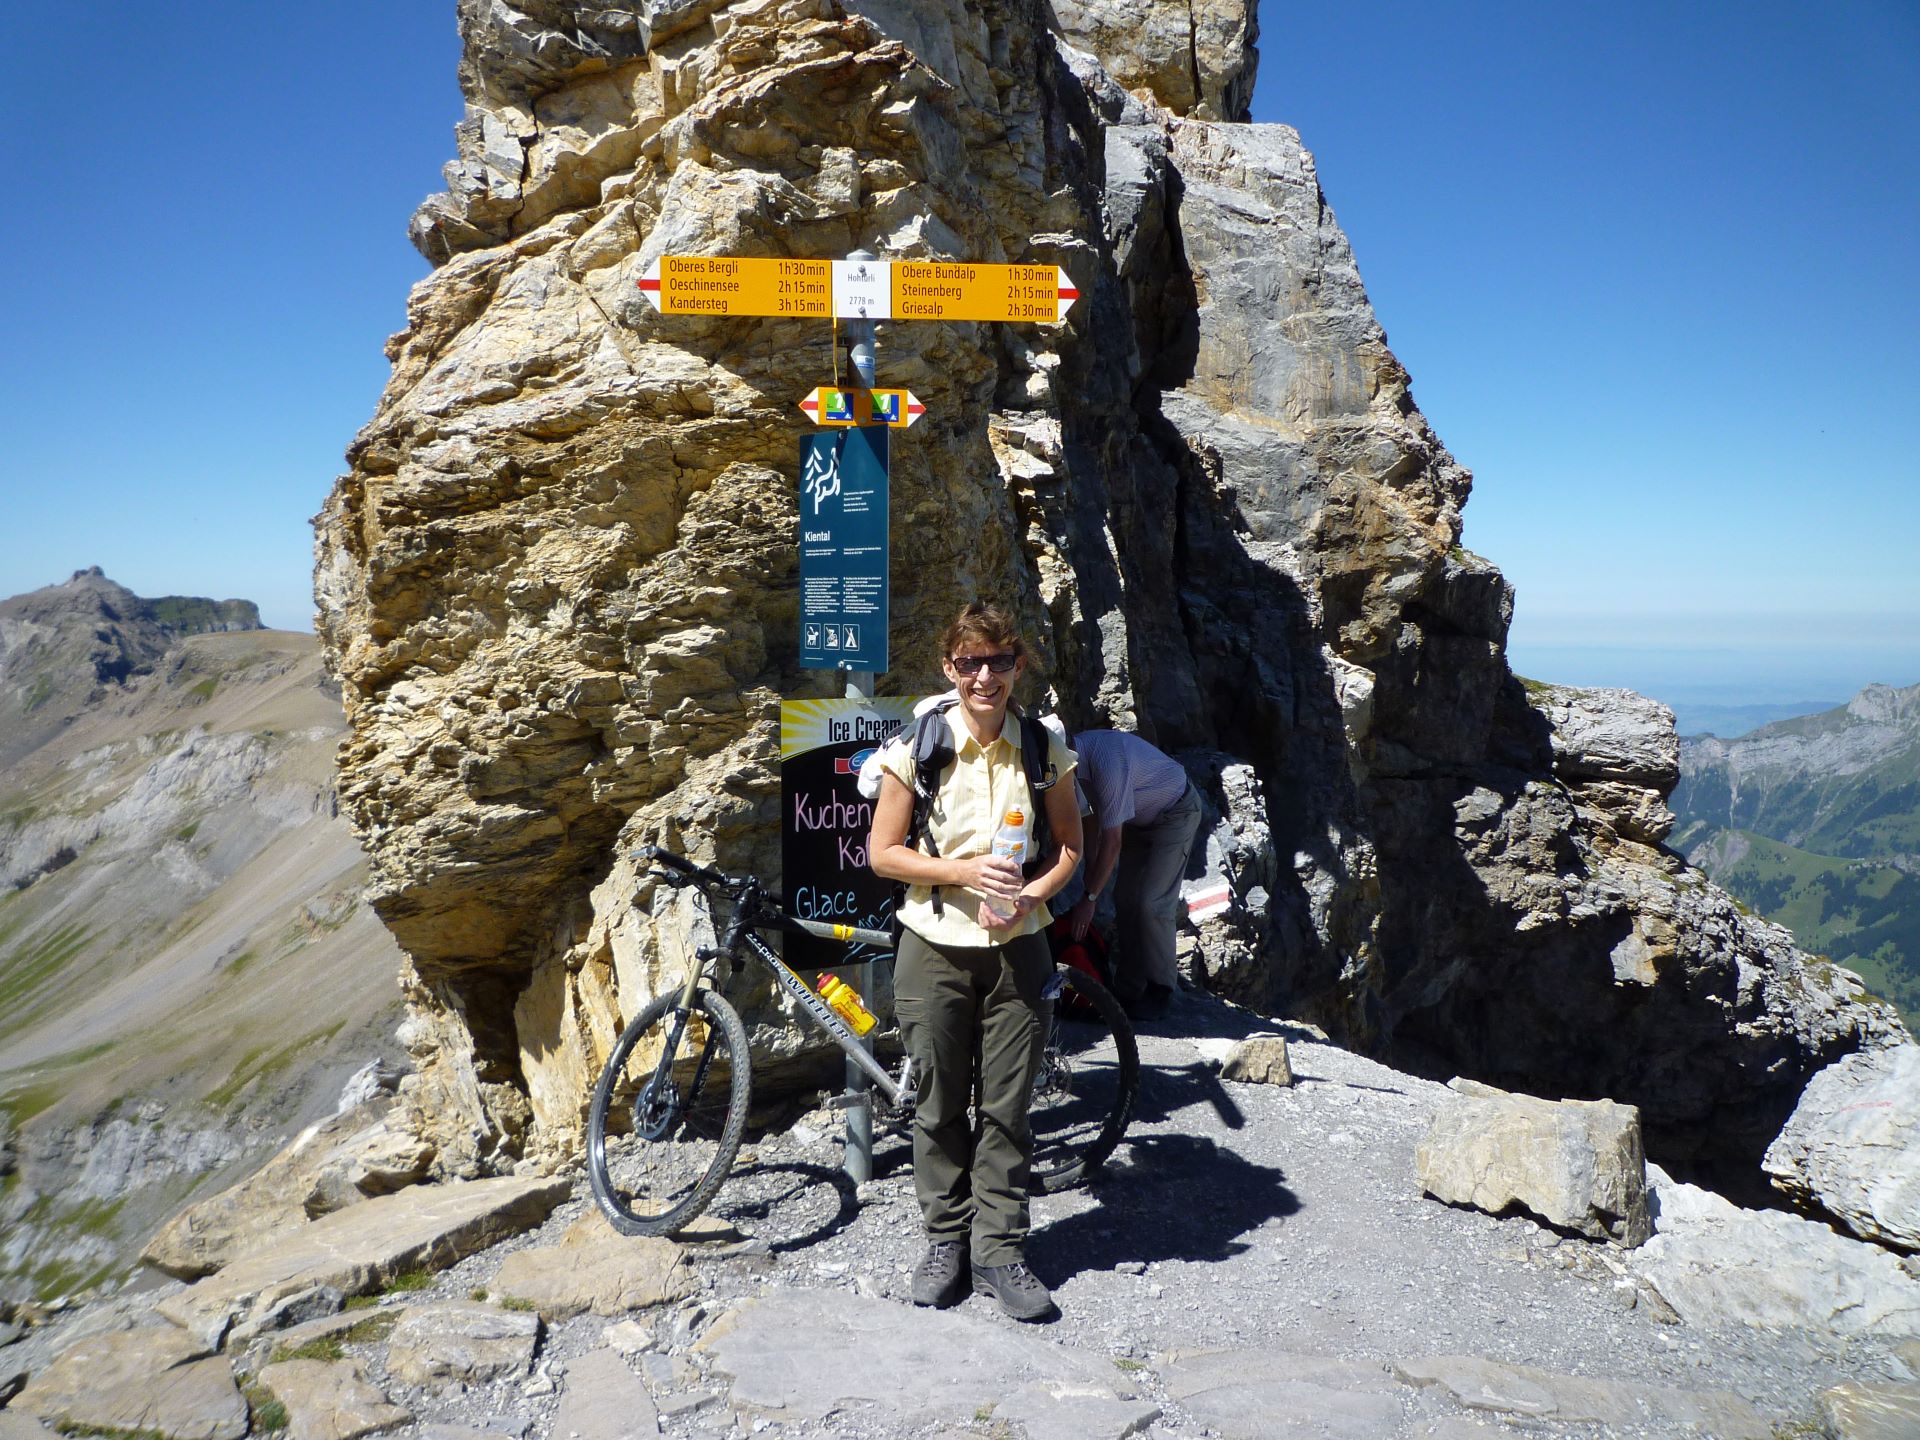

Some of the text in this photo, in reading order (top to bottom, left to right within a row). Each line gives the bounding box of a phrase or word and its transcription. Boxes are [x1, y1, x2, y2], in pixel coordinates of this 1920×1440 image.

[669, 259, 738, 277] Oberes Bergli
[902, 265, 976, 283] Obere Bundalp
[669, 277, 740, 292] Oeschinensee
[902, 283, 962, 301] Steinenberg
[670, 295, 728, 313] Kandersteg
[849, 296, 866, 305] 2778
[902, 301, 943, 318] Griesalp
[834, 392, 843, 409] 1
[880, 393, 890, 410] 1
[805, 530, 831, 542] Kiental
[828, 717, 850, 742] Ice
[795, 788, 872, 833] Kuchen
[786, 975, 850, 1040] WHEELER
